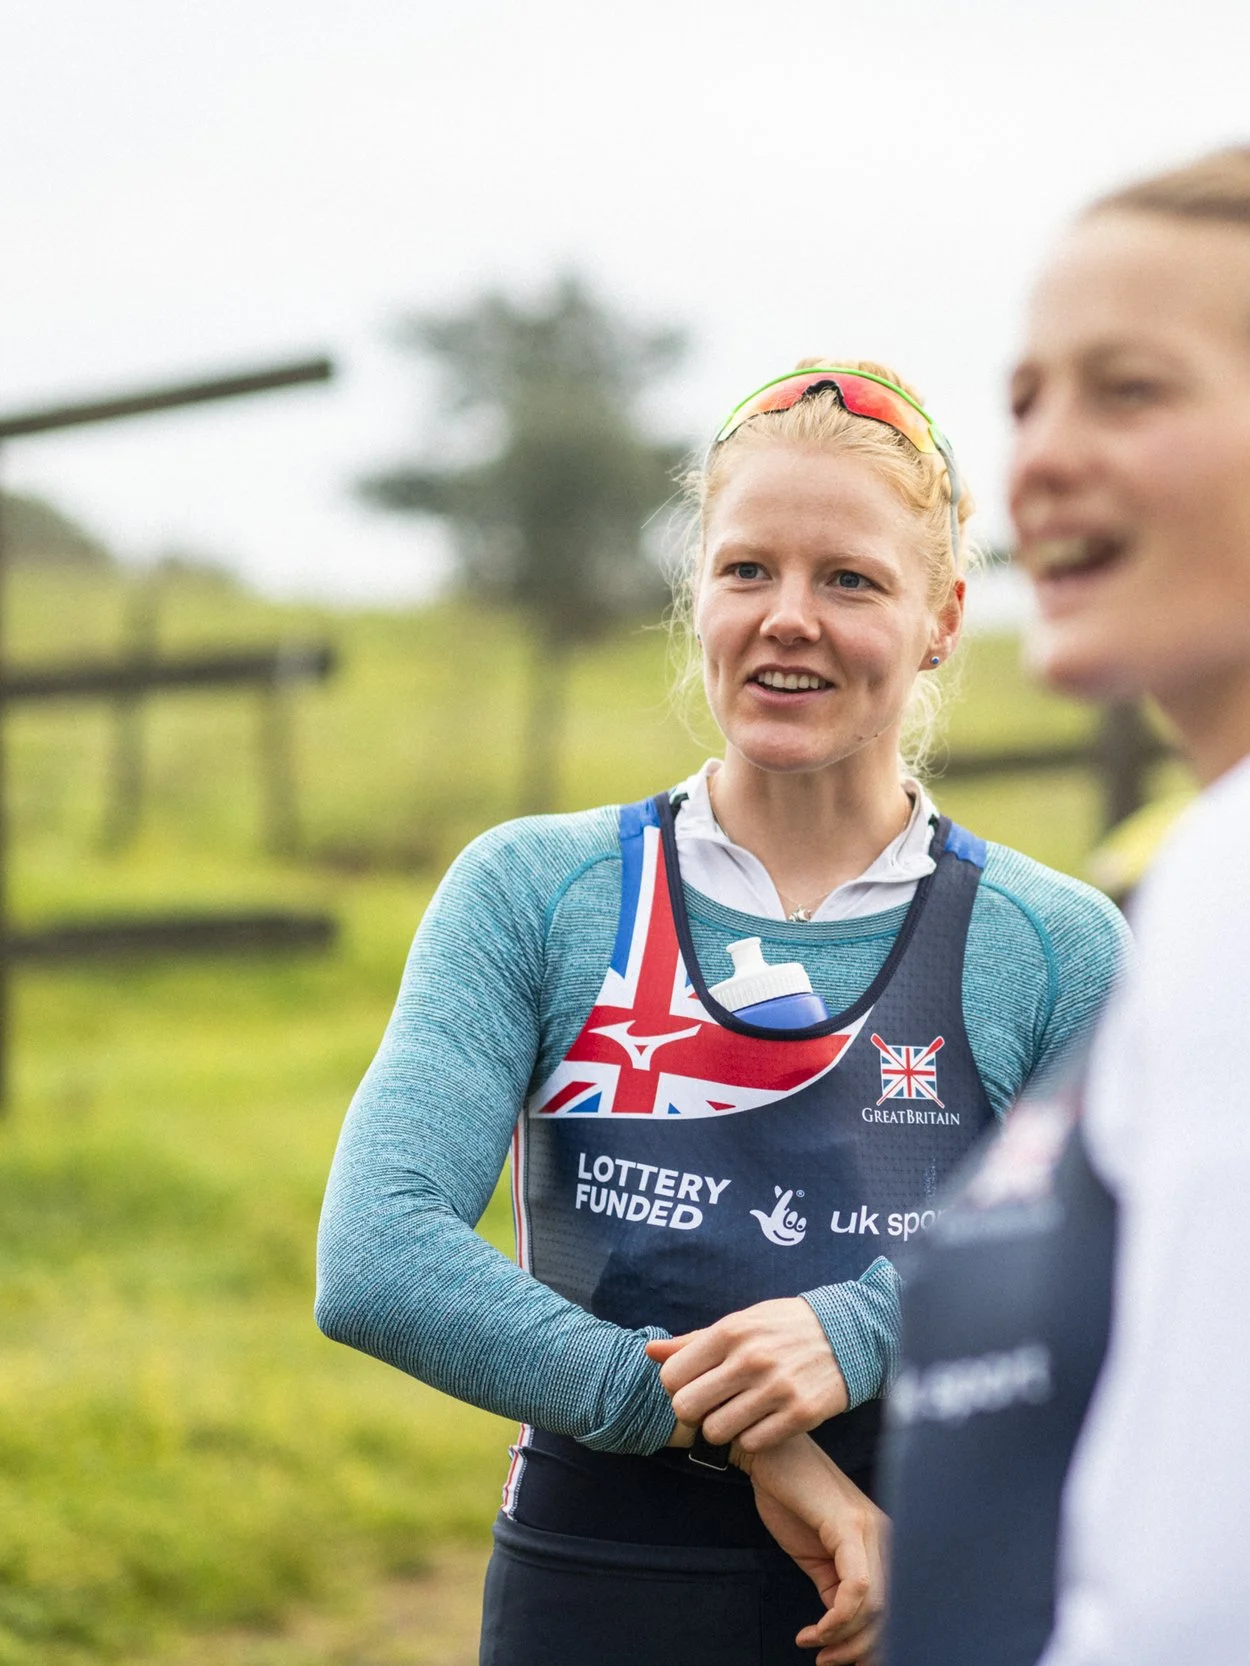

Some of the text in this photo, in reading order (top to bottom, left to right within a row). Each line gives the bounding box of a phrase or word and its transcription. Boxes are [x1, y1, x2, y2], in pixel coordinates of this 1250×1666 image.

[578, 1152, 732, 1205] LOTTERY
[575, 1183, 703, 1230] FUNDED
[830, 1205, 880, 1235] uk
[887, 1209, 948, 1242] spor
